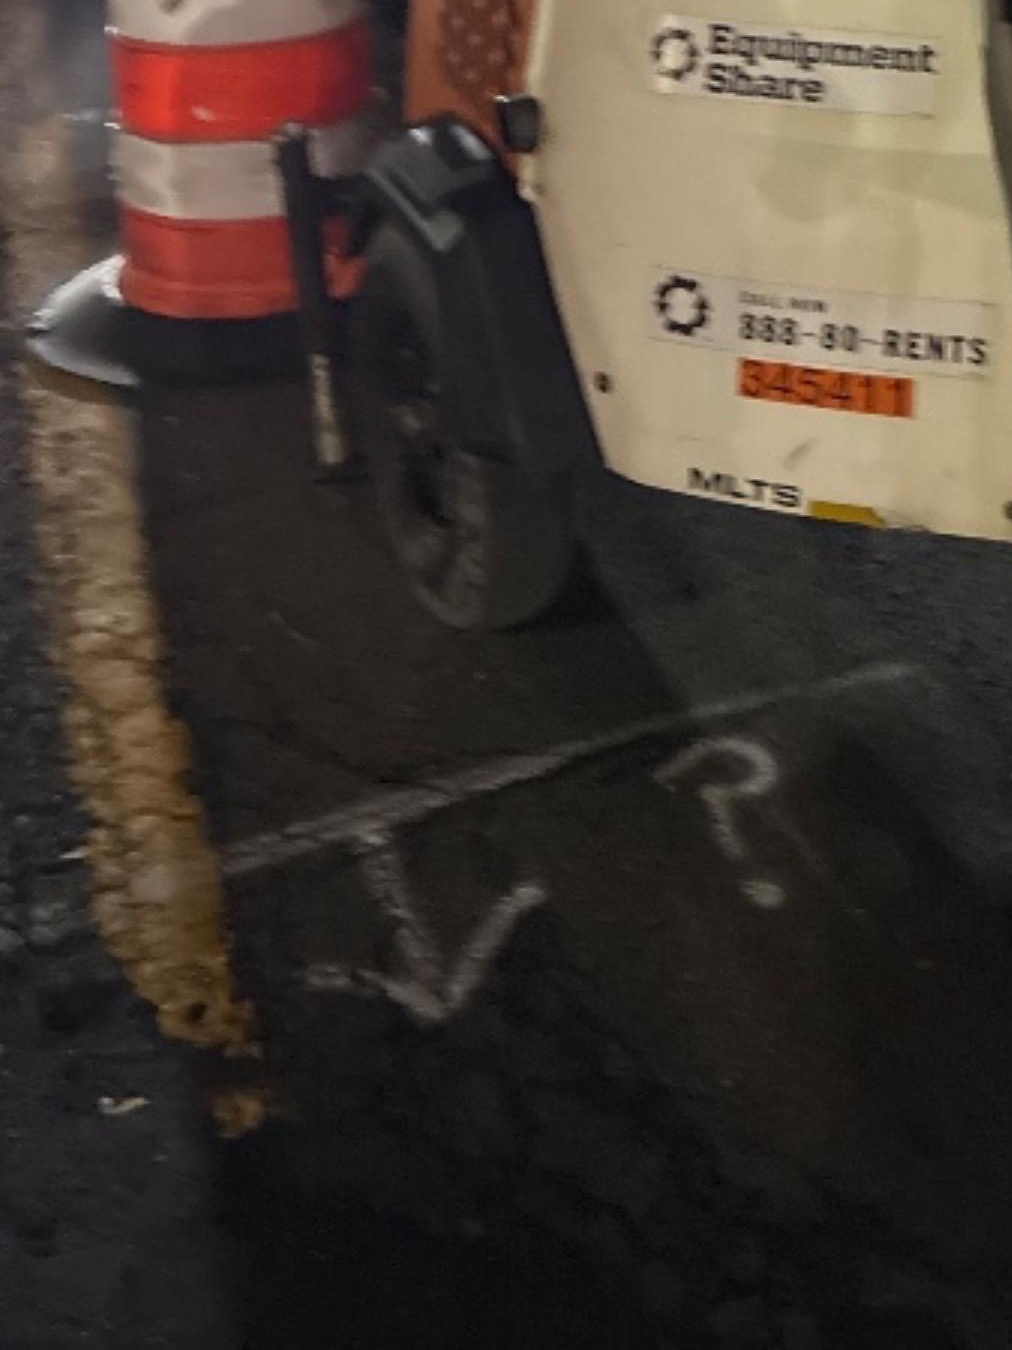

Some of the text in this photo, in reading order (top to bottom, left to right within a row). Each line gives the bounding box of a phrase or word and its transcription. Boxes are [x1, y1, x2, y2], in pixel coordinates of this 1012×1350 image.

[708, 24, 938, 73] Equipment
[705, 63, 824, 102] Share
[738, 312, 988, 366] 888-80-RENTS
[740, 358, 908, 416] 345411
[687, 467, 802, 508] MLTS
